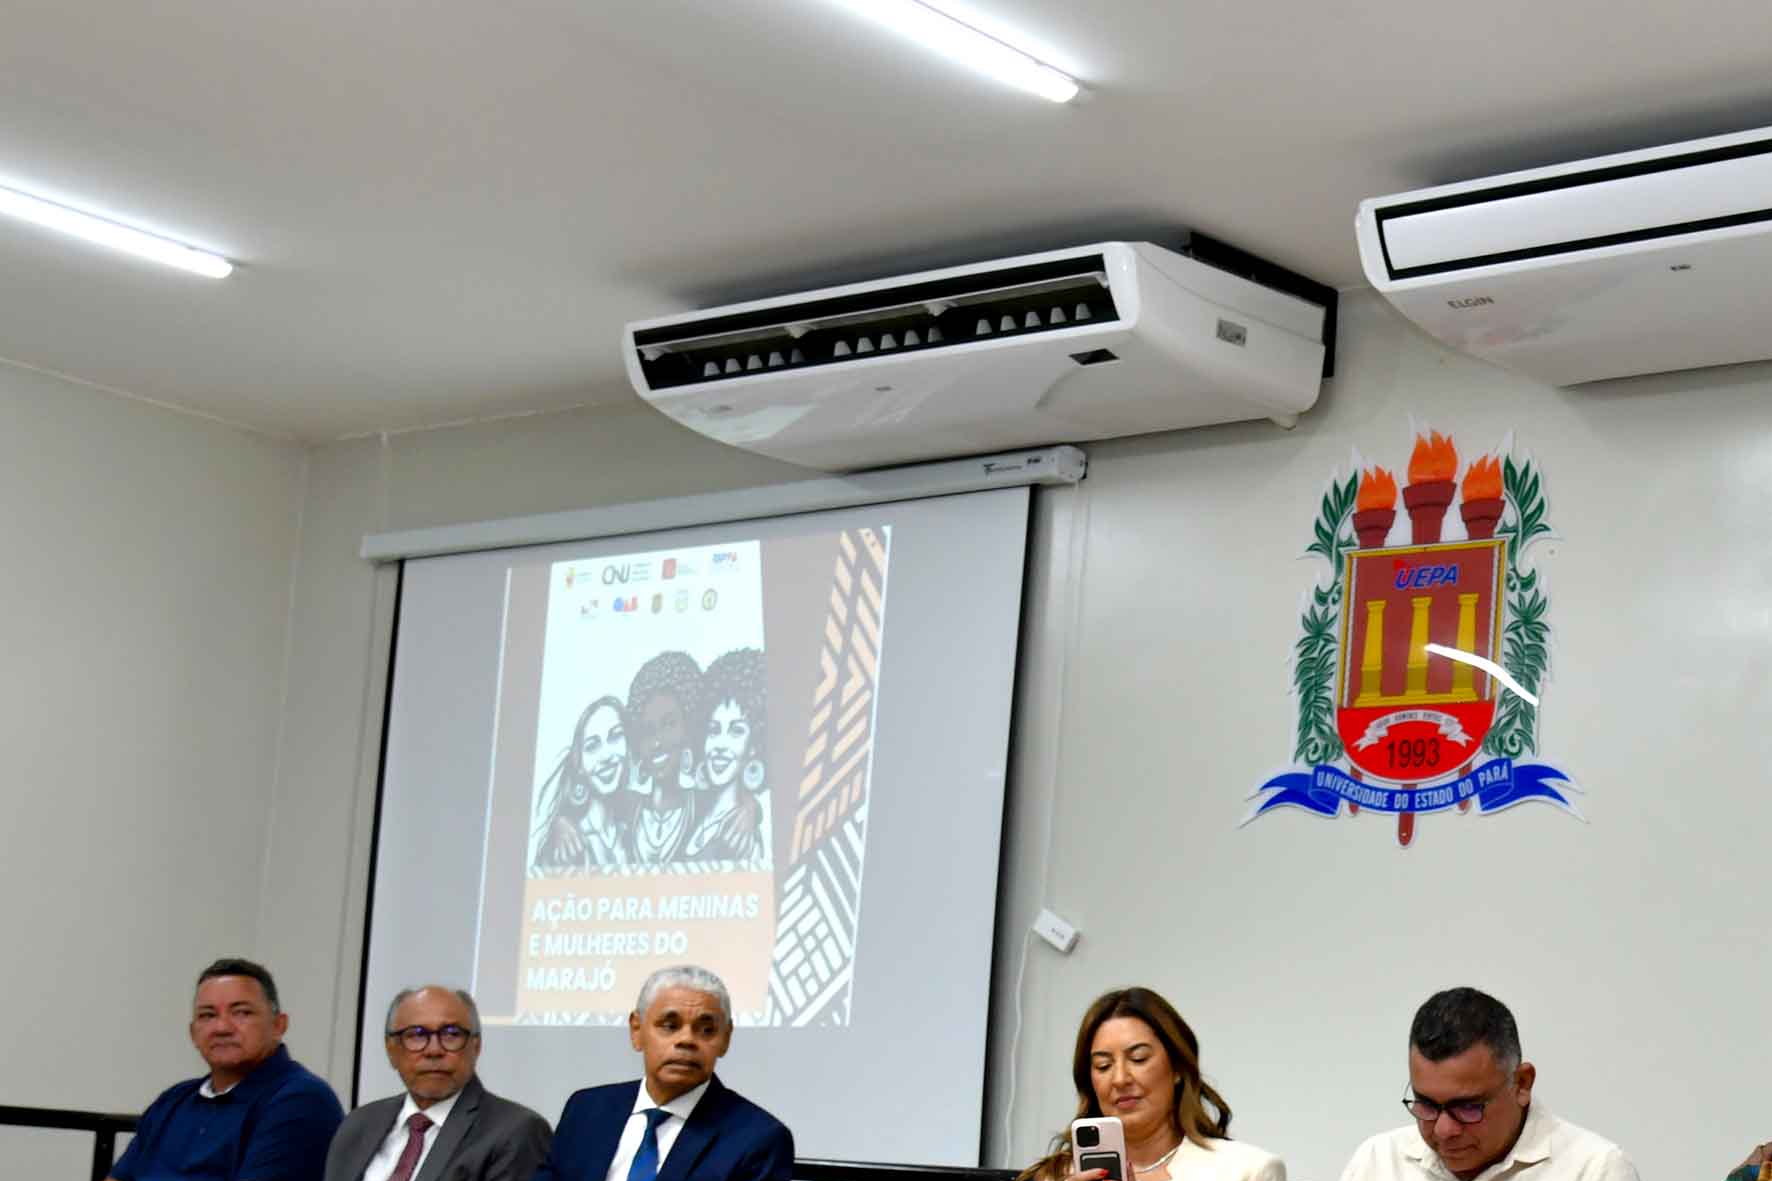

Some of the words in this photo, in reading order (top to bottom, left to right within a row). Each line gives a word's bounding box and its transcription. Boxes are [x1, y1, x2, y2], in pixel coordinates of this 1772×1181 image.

[1395, 563, 1458, 590] UEPA
[1386, 737, 1441, 768] 1993
[1316, 770, 1388, 808] UNIVERSIDADE
[1394, 794, 1409, 809] DO
[1414, 788, 1454, 808] ESTADO
[1458, 779, 1474, 796] DO
[1478, 761, 1510, 783] PARÁ
[532, 893, 592, 929] AÇÃO
[597, 896, 653, 920] PARA
[656, 894, 760, 920] MENINAS
[528, 933, 541, 956] E
[544, 931, 650, 956] MULHERES
[654, 931, 688, 955] DO
[526, 960, 616, 991] MARAJÓ
